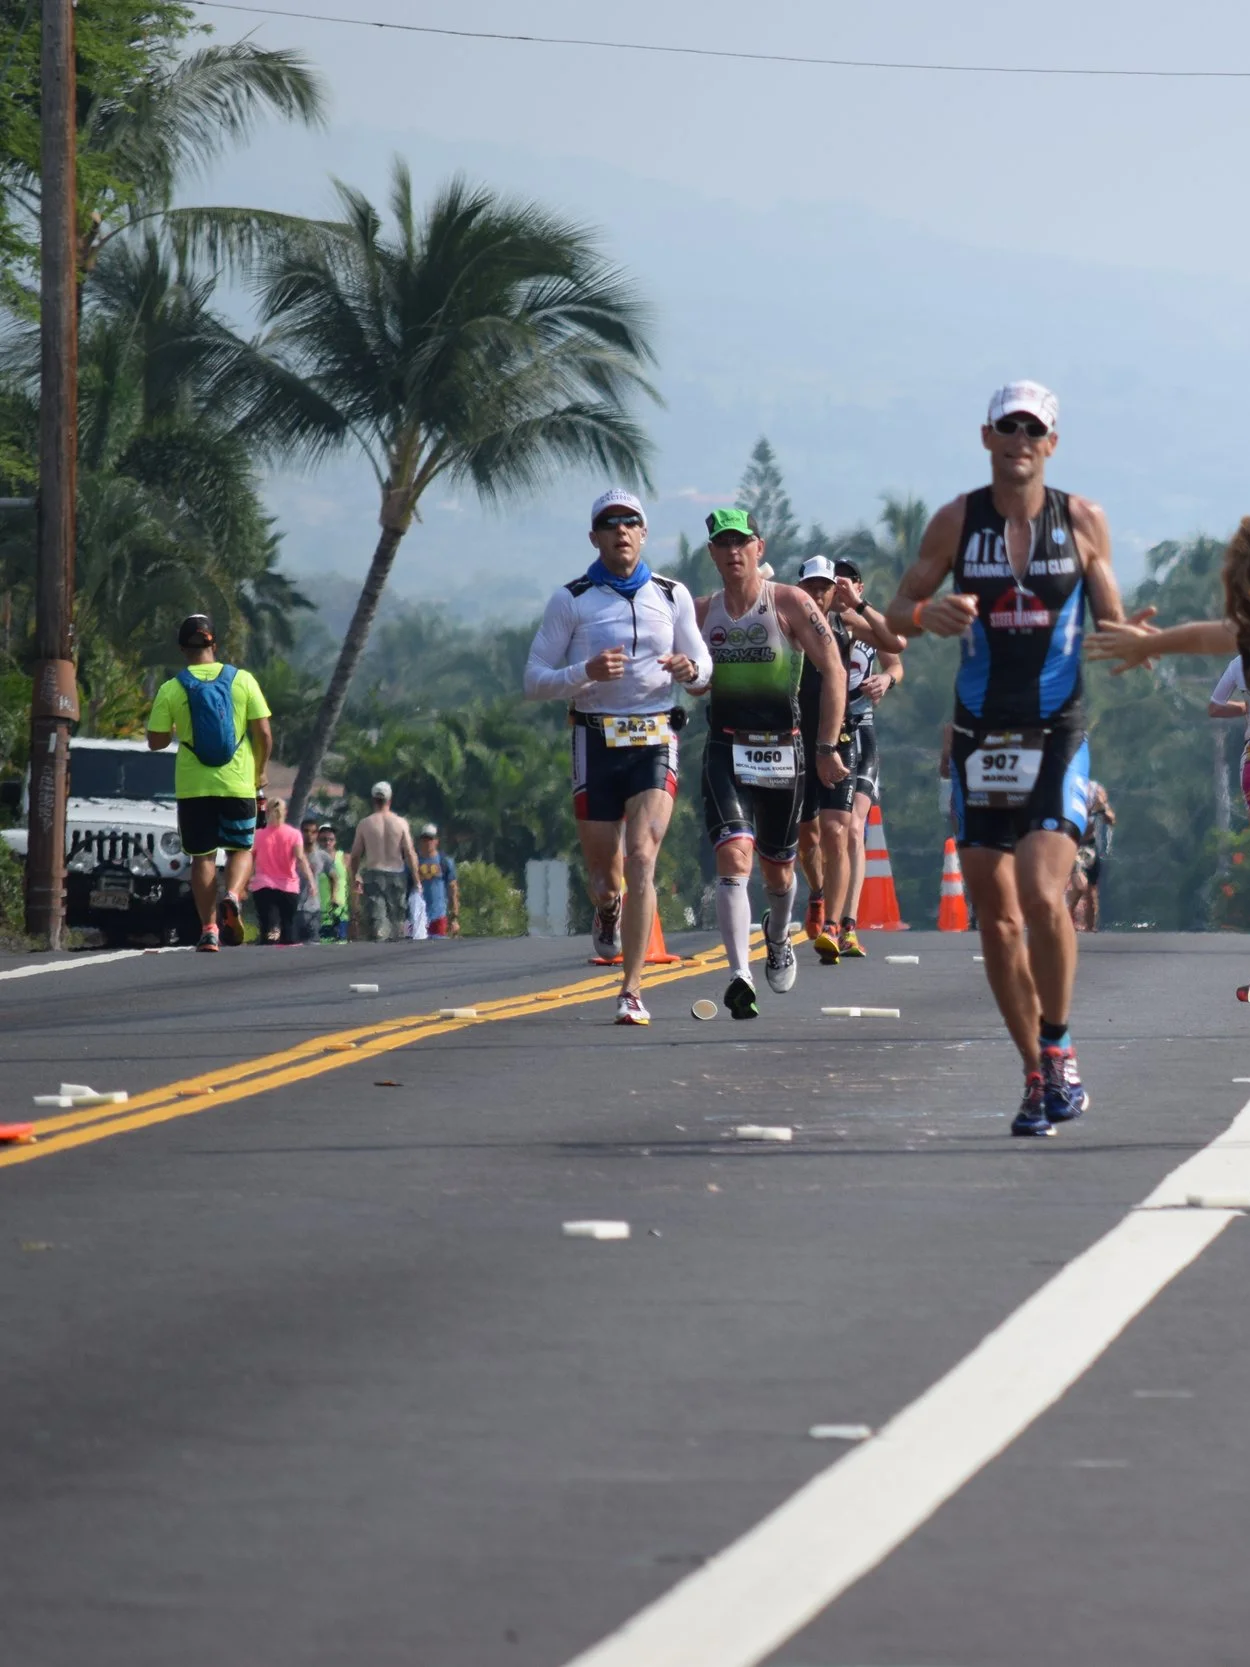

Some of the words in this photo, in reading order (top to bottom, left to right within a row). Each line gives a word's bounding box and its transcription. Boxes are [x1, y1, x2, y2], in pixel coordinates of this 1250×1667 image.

[617, 719, 656, 733] 2423
[744, 750, 782, 763] 1060
[982, 754, 1019, 770] 907
